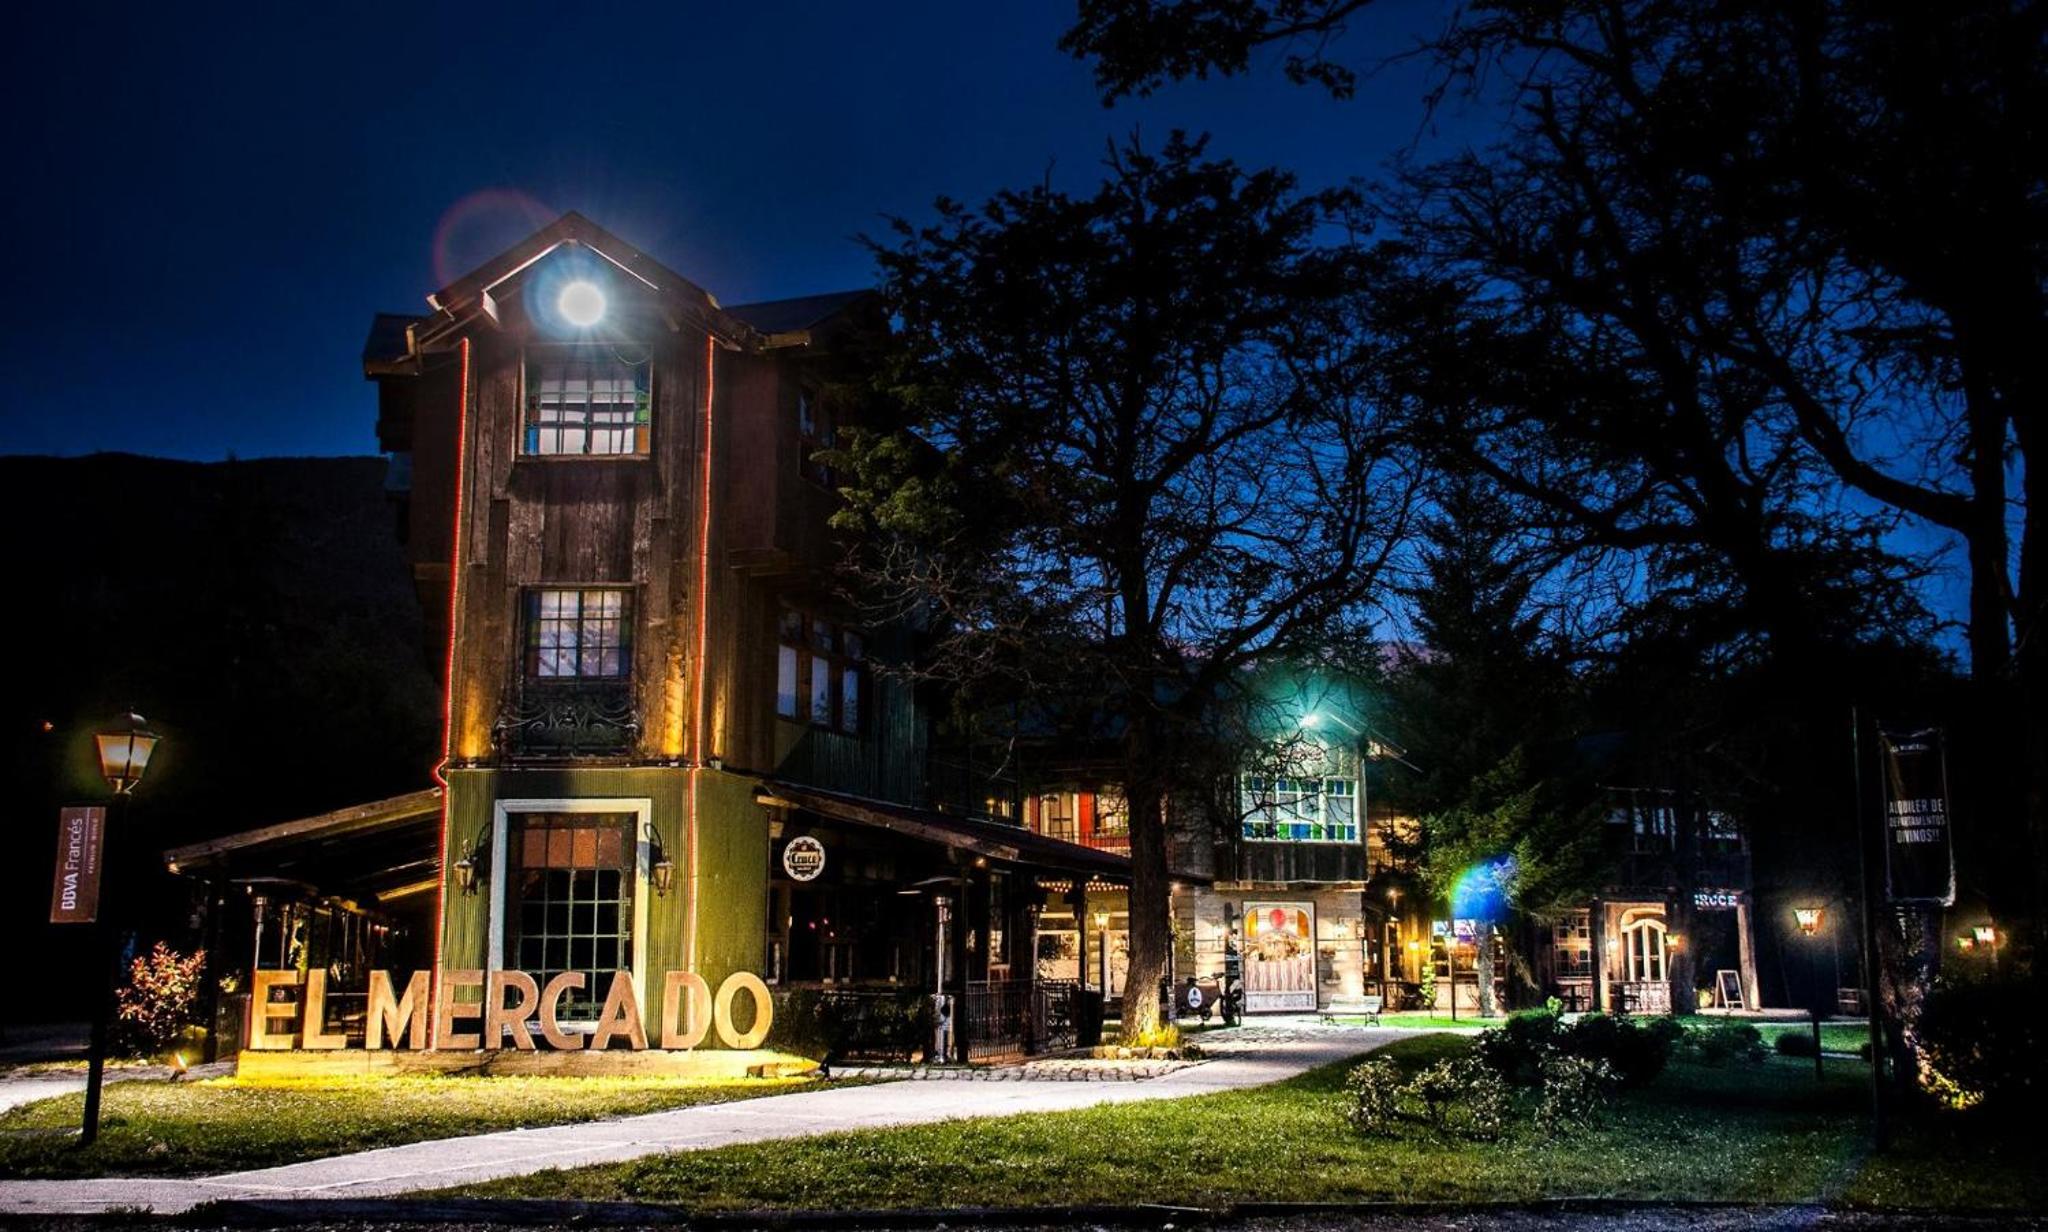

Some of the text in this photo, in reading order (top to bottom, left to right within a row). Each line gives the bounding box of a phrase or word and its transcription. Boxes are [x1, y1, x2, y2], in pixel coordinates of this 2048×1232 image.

[1889, 799, 1944, 815] ALQUILER DE
[61, 818, 83, 910] BBVA Francés
[249, 969, 774, 1050] EL MERCADO
